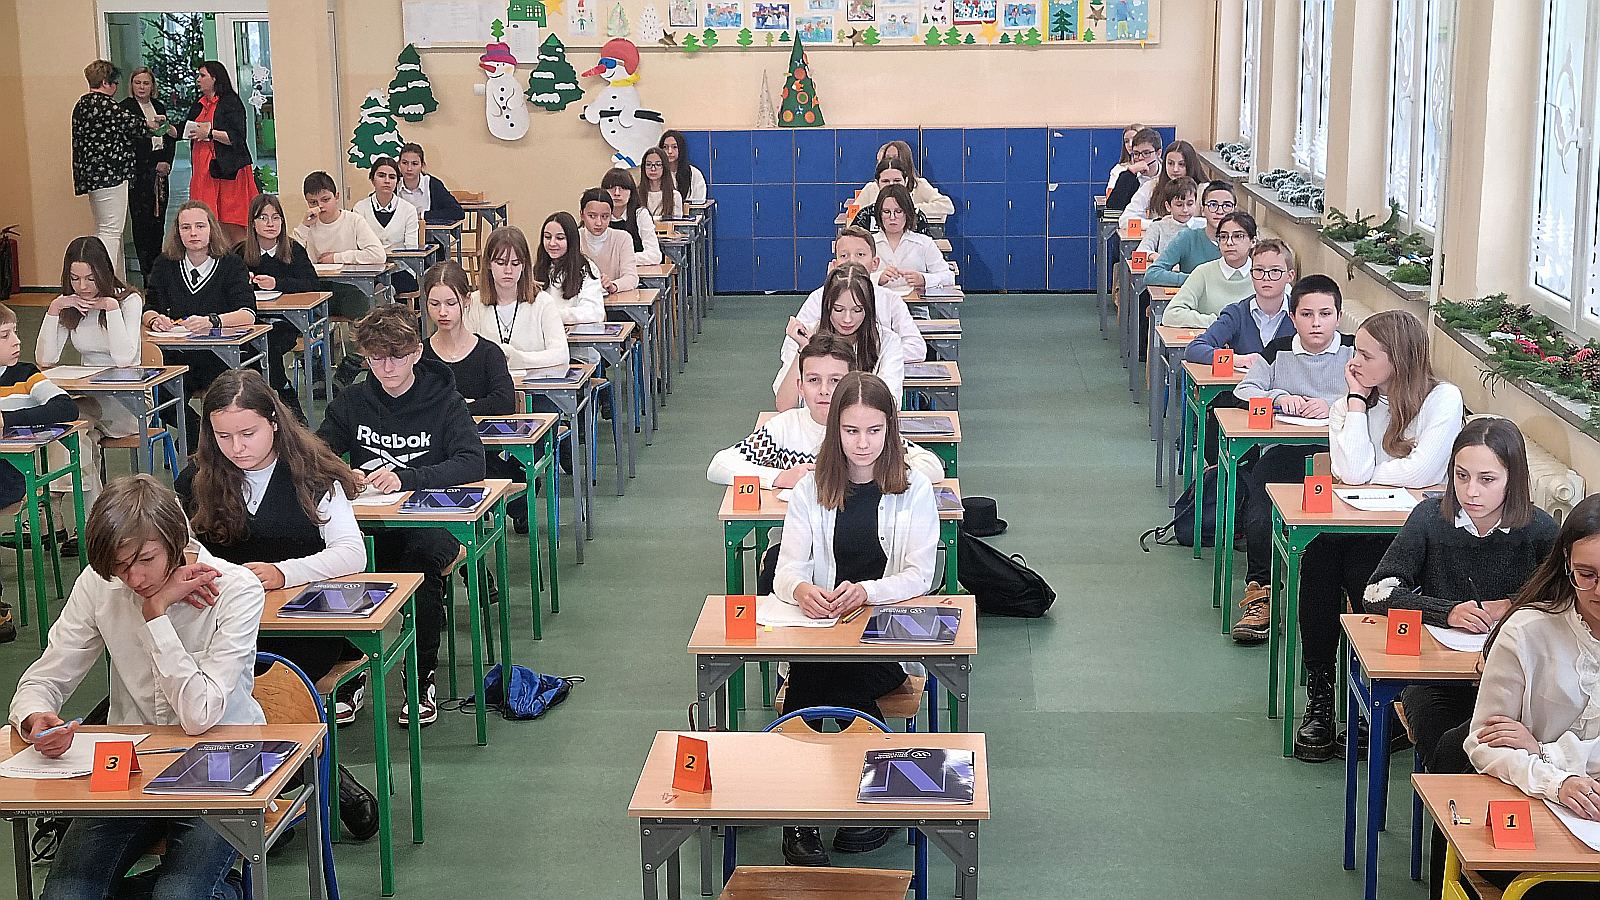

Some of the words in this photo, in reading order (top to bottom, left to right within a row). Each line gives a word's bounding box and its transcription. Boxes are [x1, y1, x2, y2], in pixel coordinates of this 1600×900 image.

[1217, 355, 1230, 364] 17
[1252, 406, 1267, 416] 15
[356, 424, 432, 449] Reebok
[738, 484, 754, 495] 10
[1314, 484, 1323, 495] 9
[735, 606, 746, 618] 7
[1397, 623, 1409, 635] 8
[105, 756, 119, 770] 3
[684, 755, 696, 770] 2
[1506, 814, 1517, 828] 1
